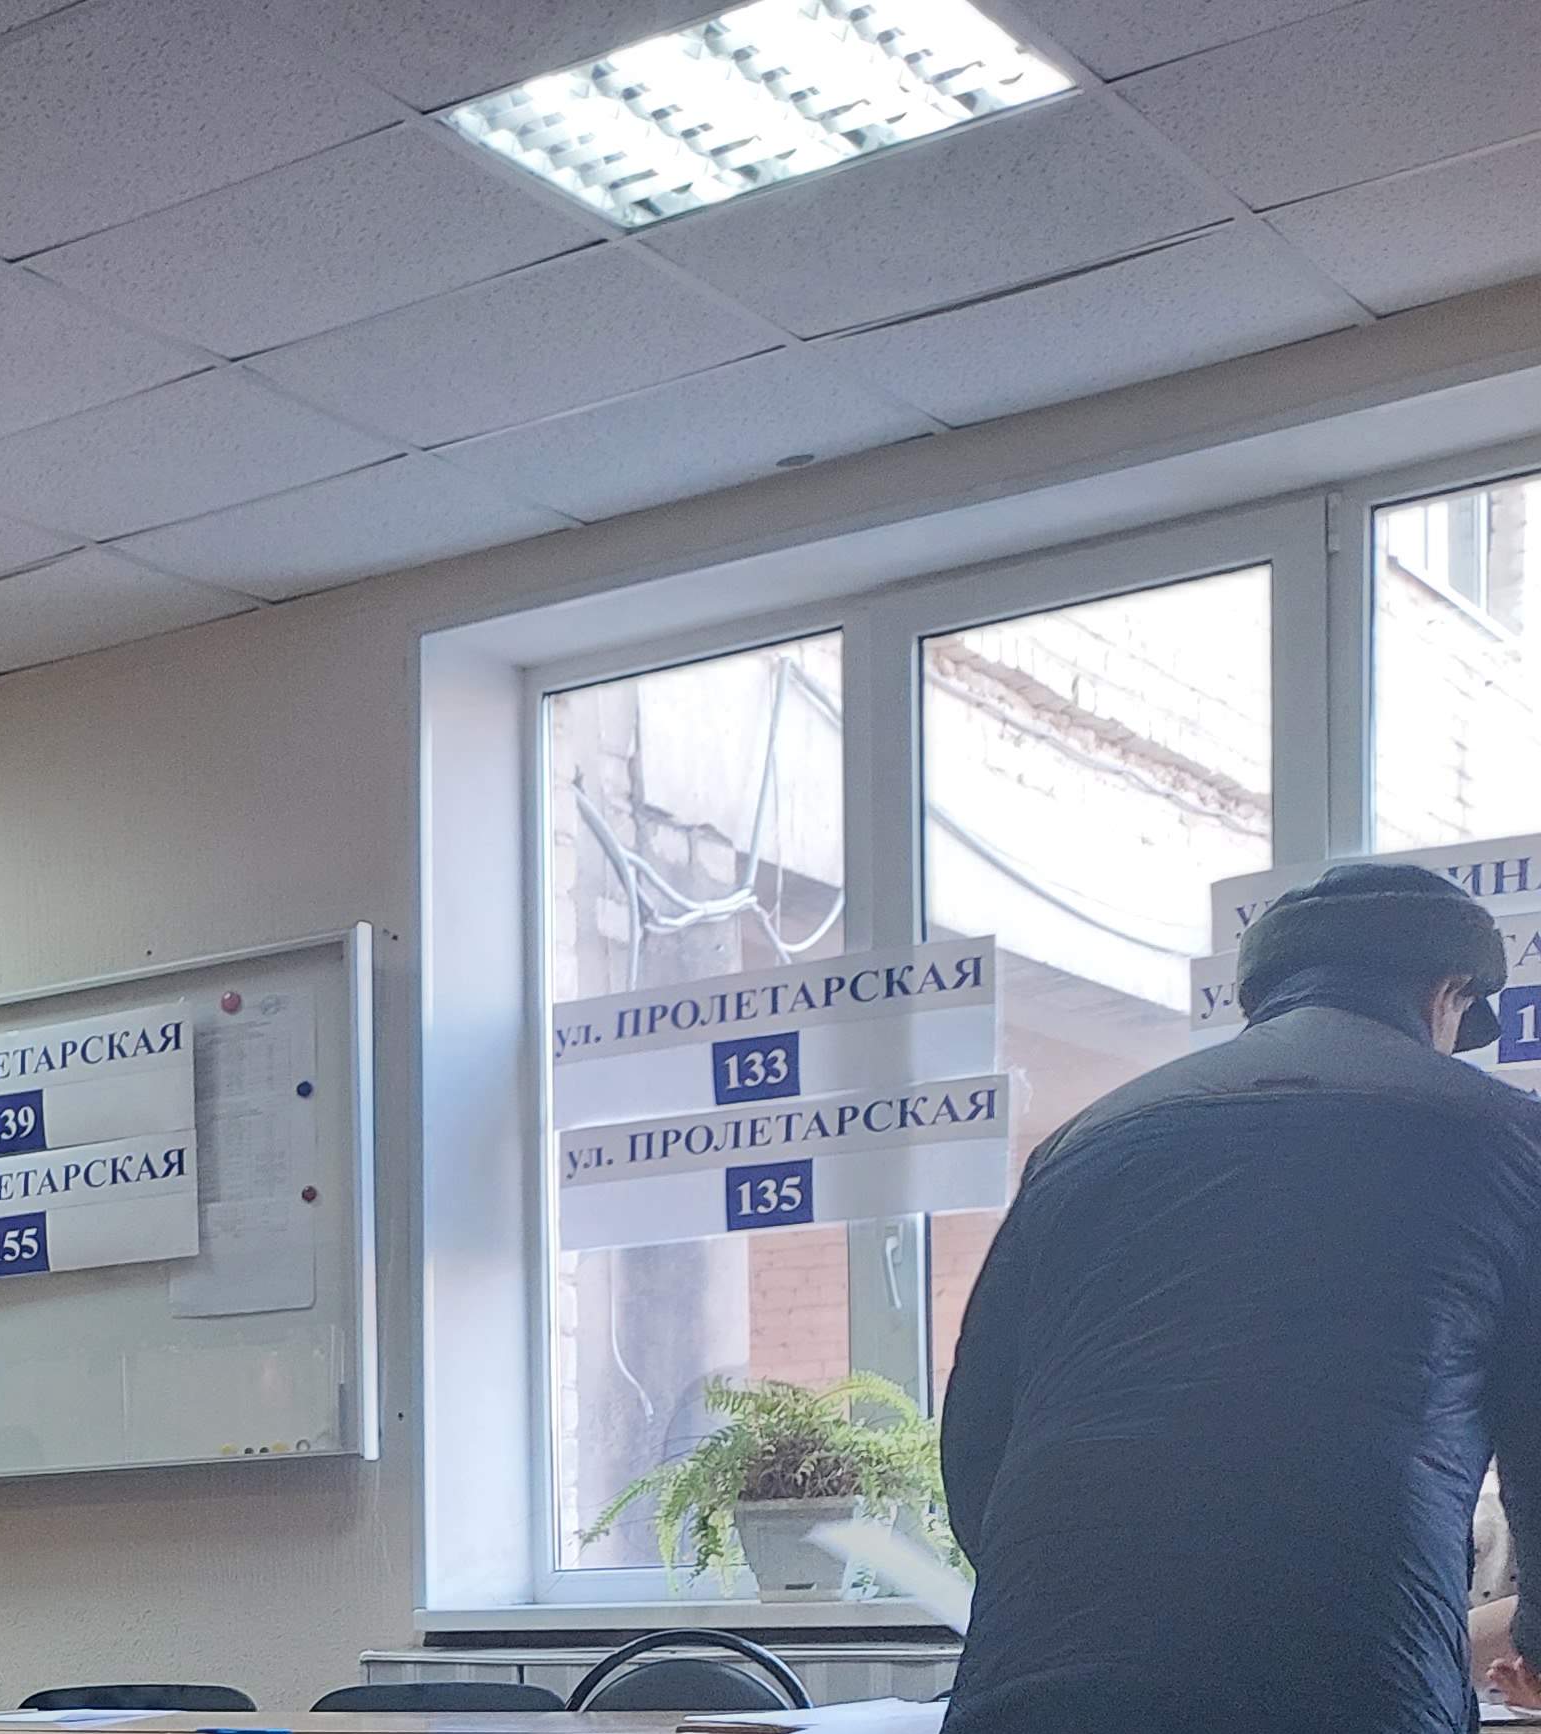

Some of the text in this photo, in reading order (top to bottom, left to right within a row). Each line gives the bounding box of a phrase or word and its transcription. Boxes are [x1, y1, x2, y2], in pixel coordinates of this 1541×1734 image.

[554, 954, 985, 1058] ул. ПРОЛЕТАРСКАЯ
[724, 1051, 790, 1092] 133
[565, 1087, 999, 1181] ул. ПРОЛЕТАРСКАЯ
[736, 1175, 804, 1217] 135
